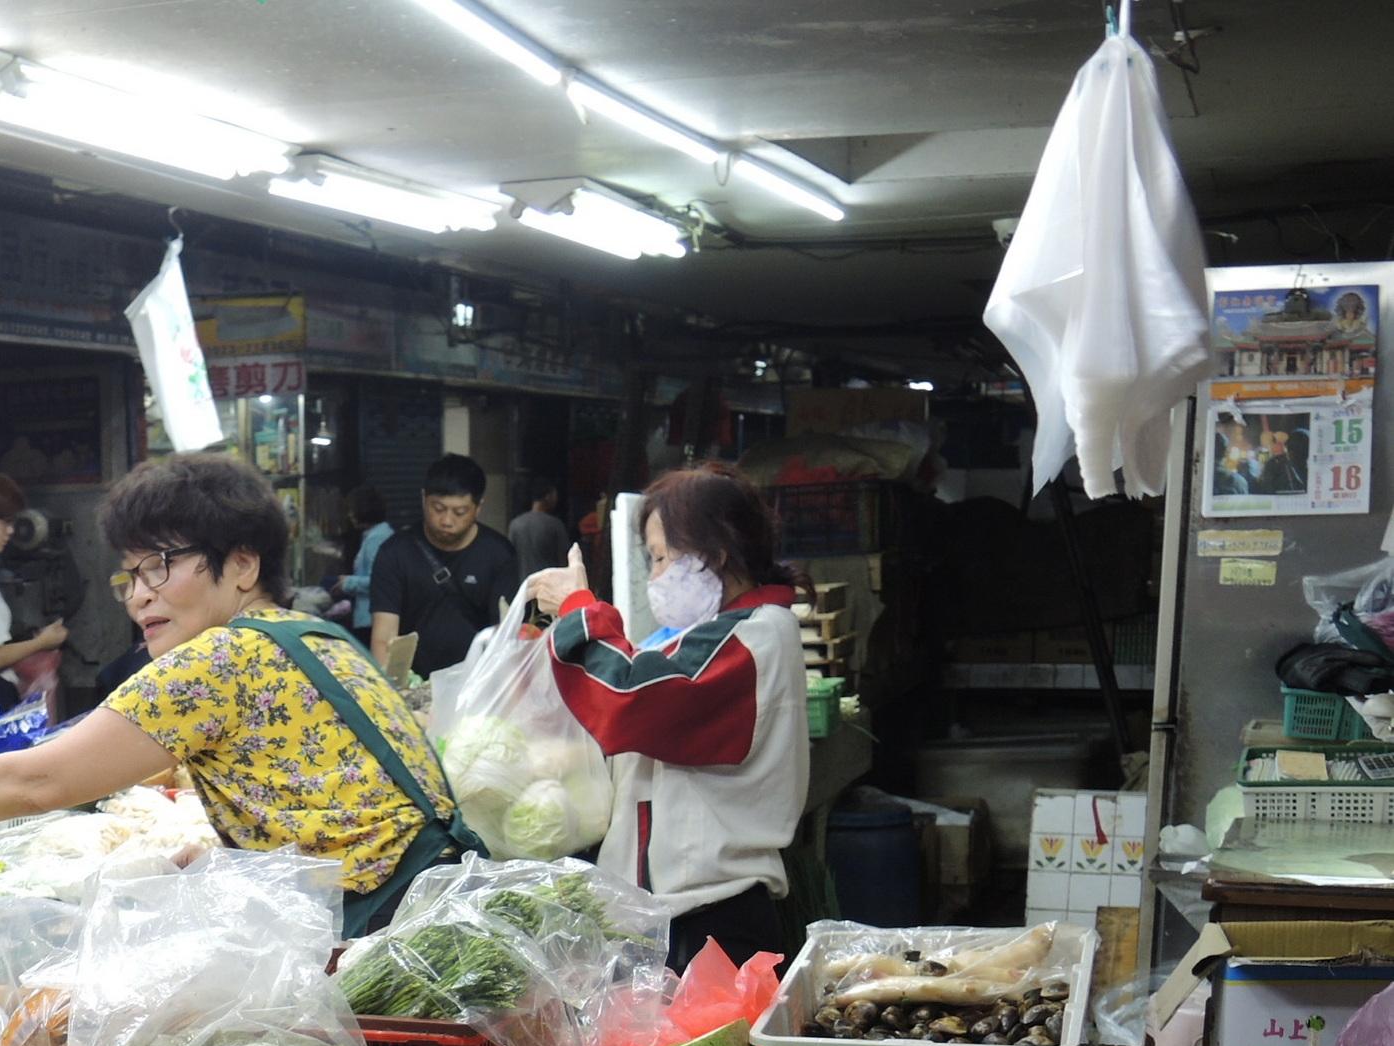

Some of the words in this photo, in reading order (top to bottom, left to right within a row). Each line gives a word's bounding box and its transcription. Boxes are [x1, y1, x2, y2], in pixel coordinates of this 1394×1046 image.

[1331, 418, 1364, 445] 15
[1329, 465, 1362, 491] 16
[1263, 1018, 1307, 1040] 山上
